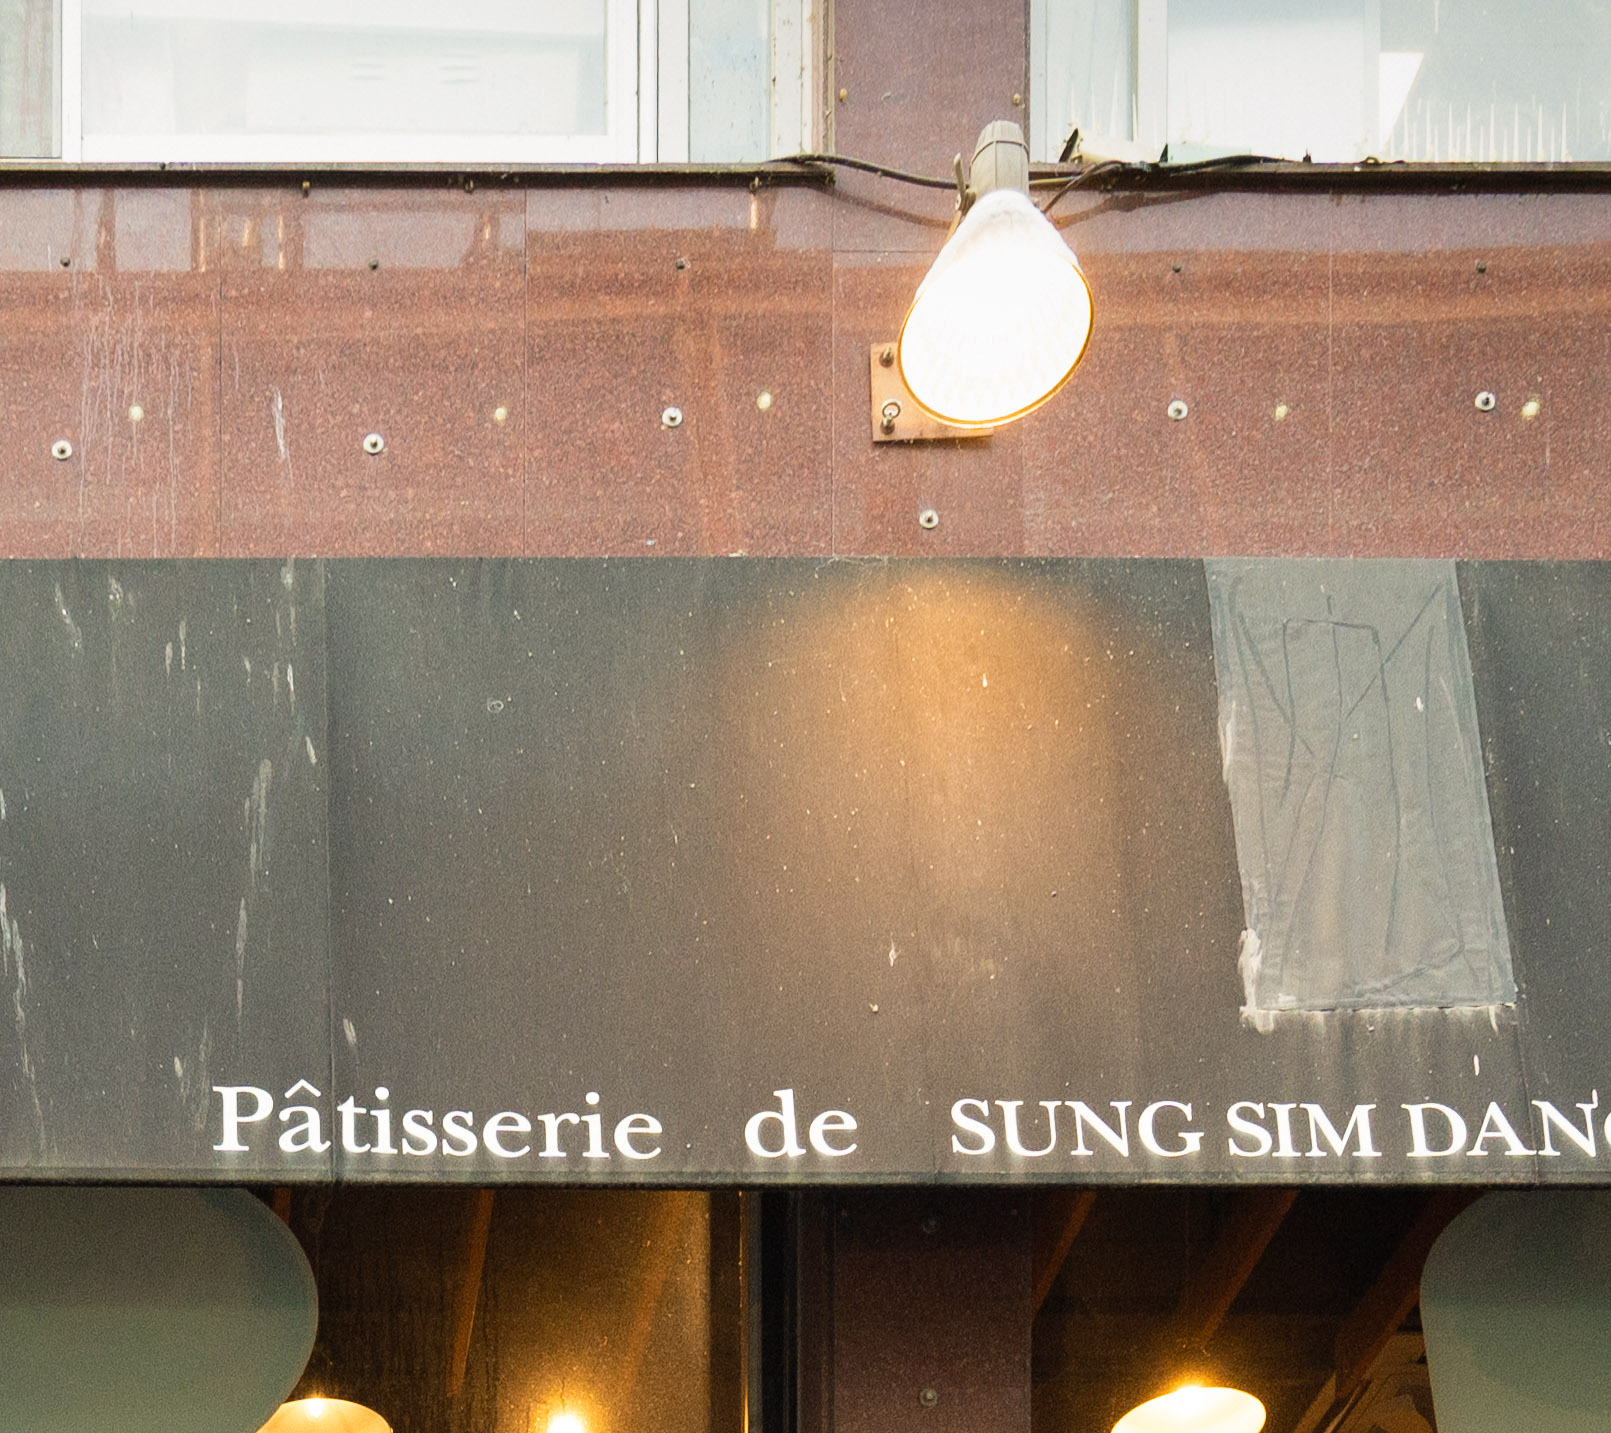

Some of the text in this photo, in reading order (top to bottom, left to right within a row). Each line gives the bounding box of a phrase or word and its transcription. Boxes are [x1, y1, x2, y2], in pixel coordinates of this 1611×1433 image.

[211, 1080, 662, 1159] Pâtisserie
[744, 1088, 860, 1159] de
[950, 1100, 1204, 1159] SUNG
[1226, 1102, 1383, 1159] SIM
